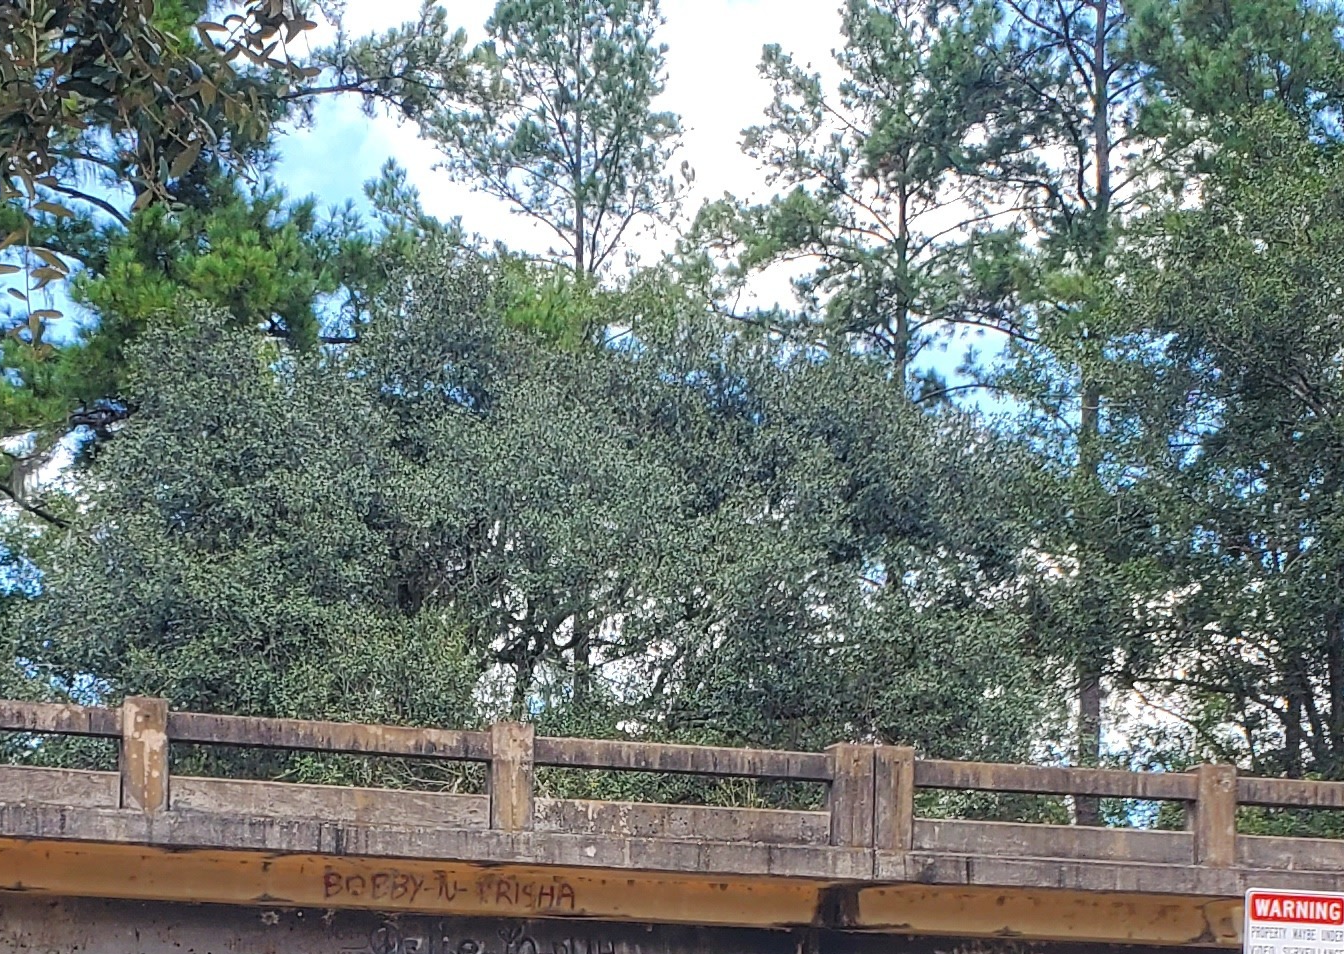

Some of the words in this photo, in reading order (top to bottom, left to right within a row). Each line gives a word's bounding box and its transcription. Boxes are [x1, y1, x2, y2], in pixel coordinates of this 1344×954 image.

[1255, 898, 1342, 921] WARNING
[1251, 925, 1287, 939] PROPERTY
[1292, 928, 1316, 940] MAYBE
[1321, 929, 1344, 942] UNDER
